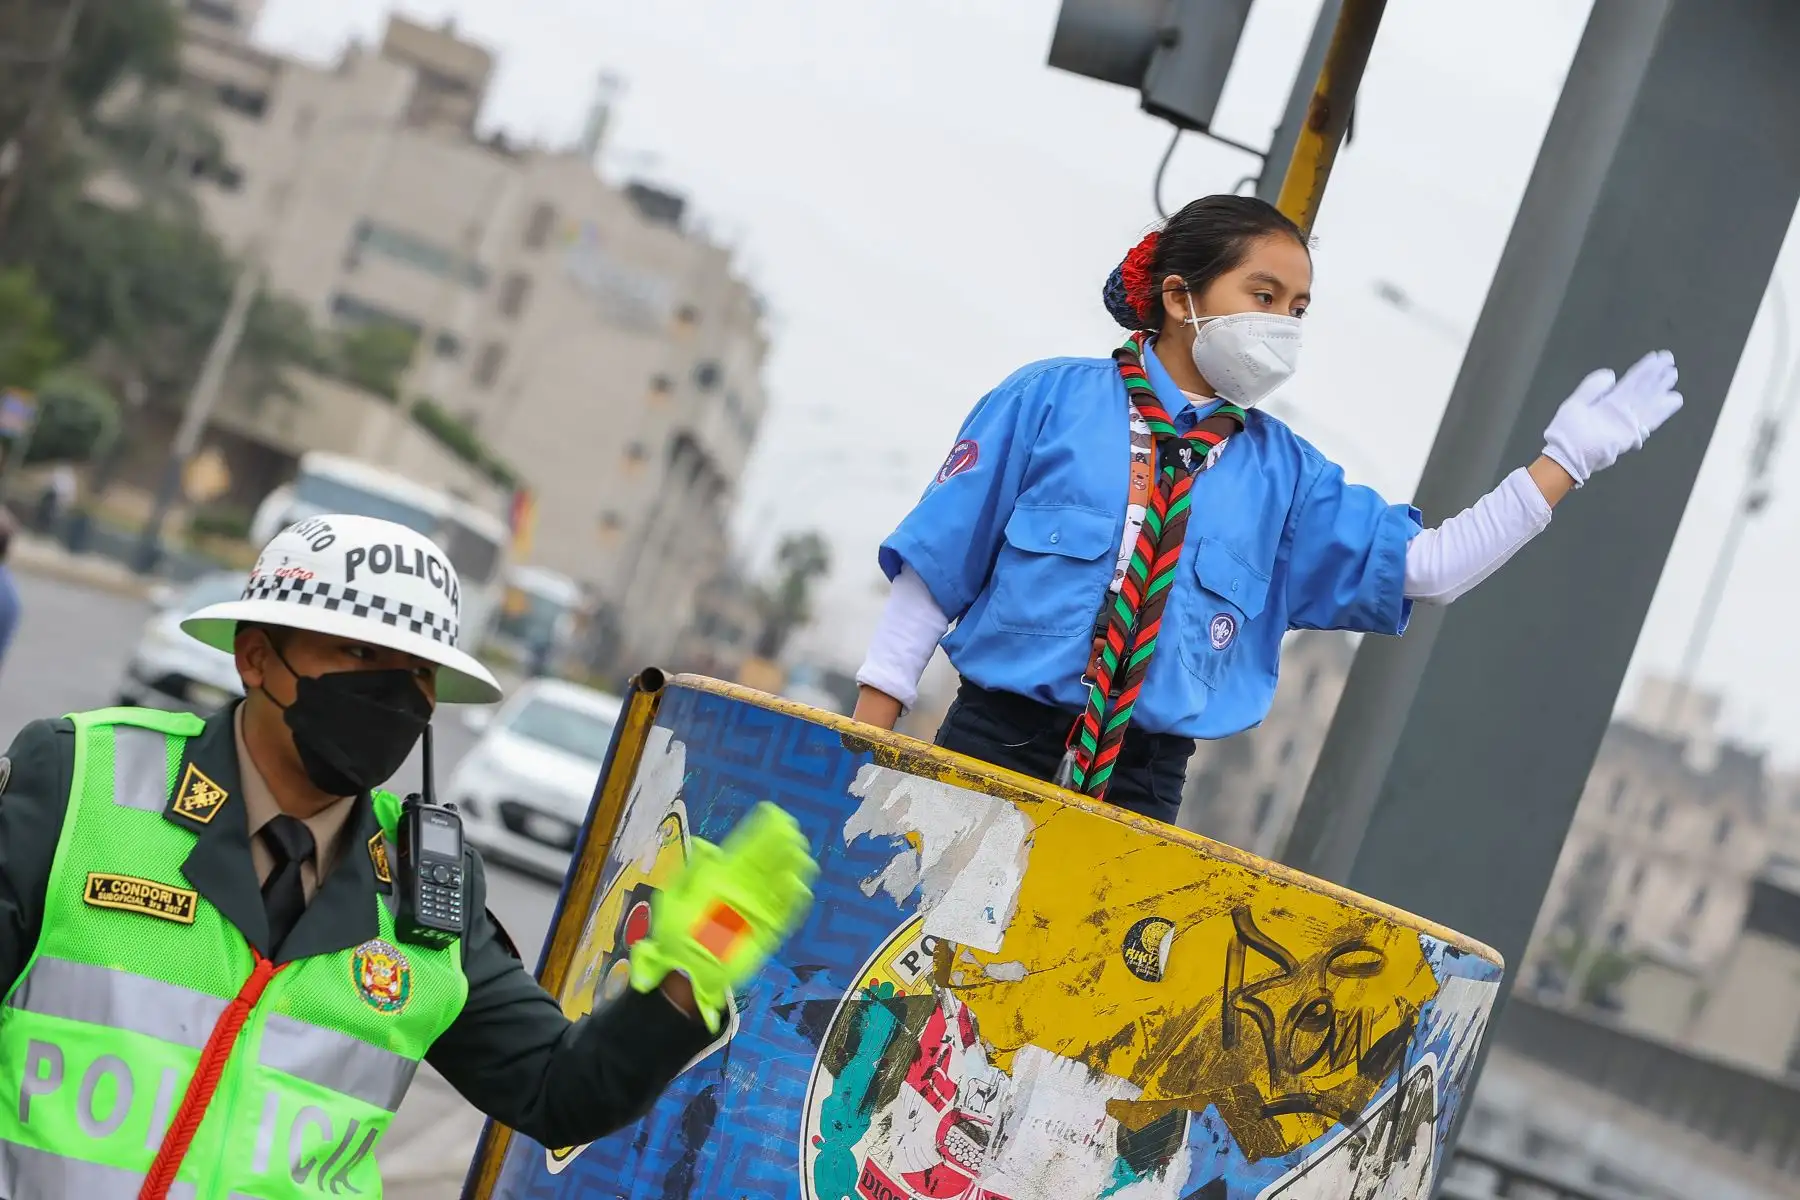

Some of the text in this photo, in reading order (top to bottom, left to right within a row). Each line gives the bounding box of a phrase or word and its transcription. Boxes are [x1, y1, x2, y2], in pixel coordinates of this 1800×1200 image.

[345, 543, 459, 618] POLICIA
[111, 880, 173, 904] CONDORI
[176, 895, 189, 908] V.
[861, 1167, 901, 1200] DIO
